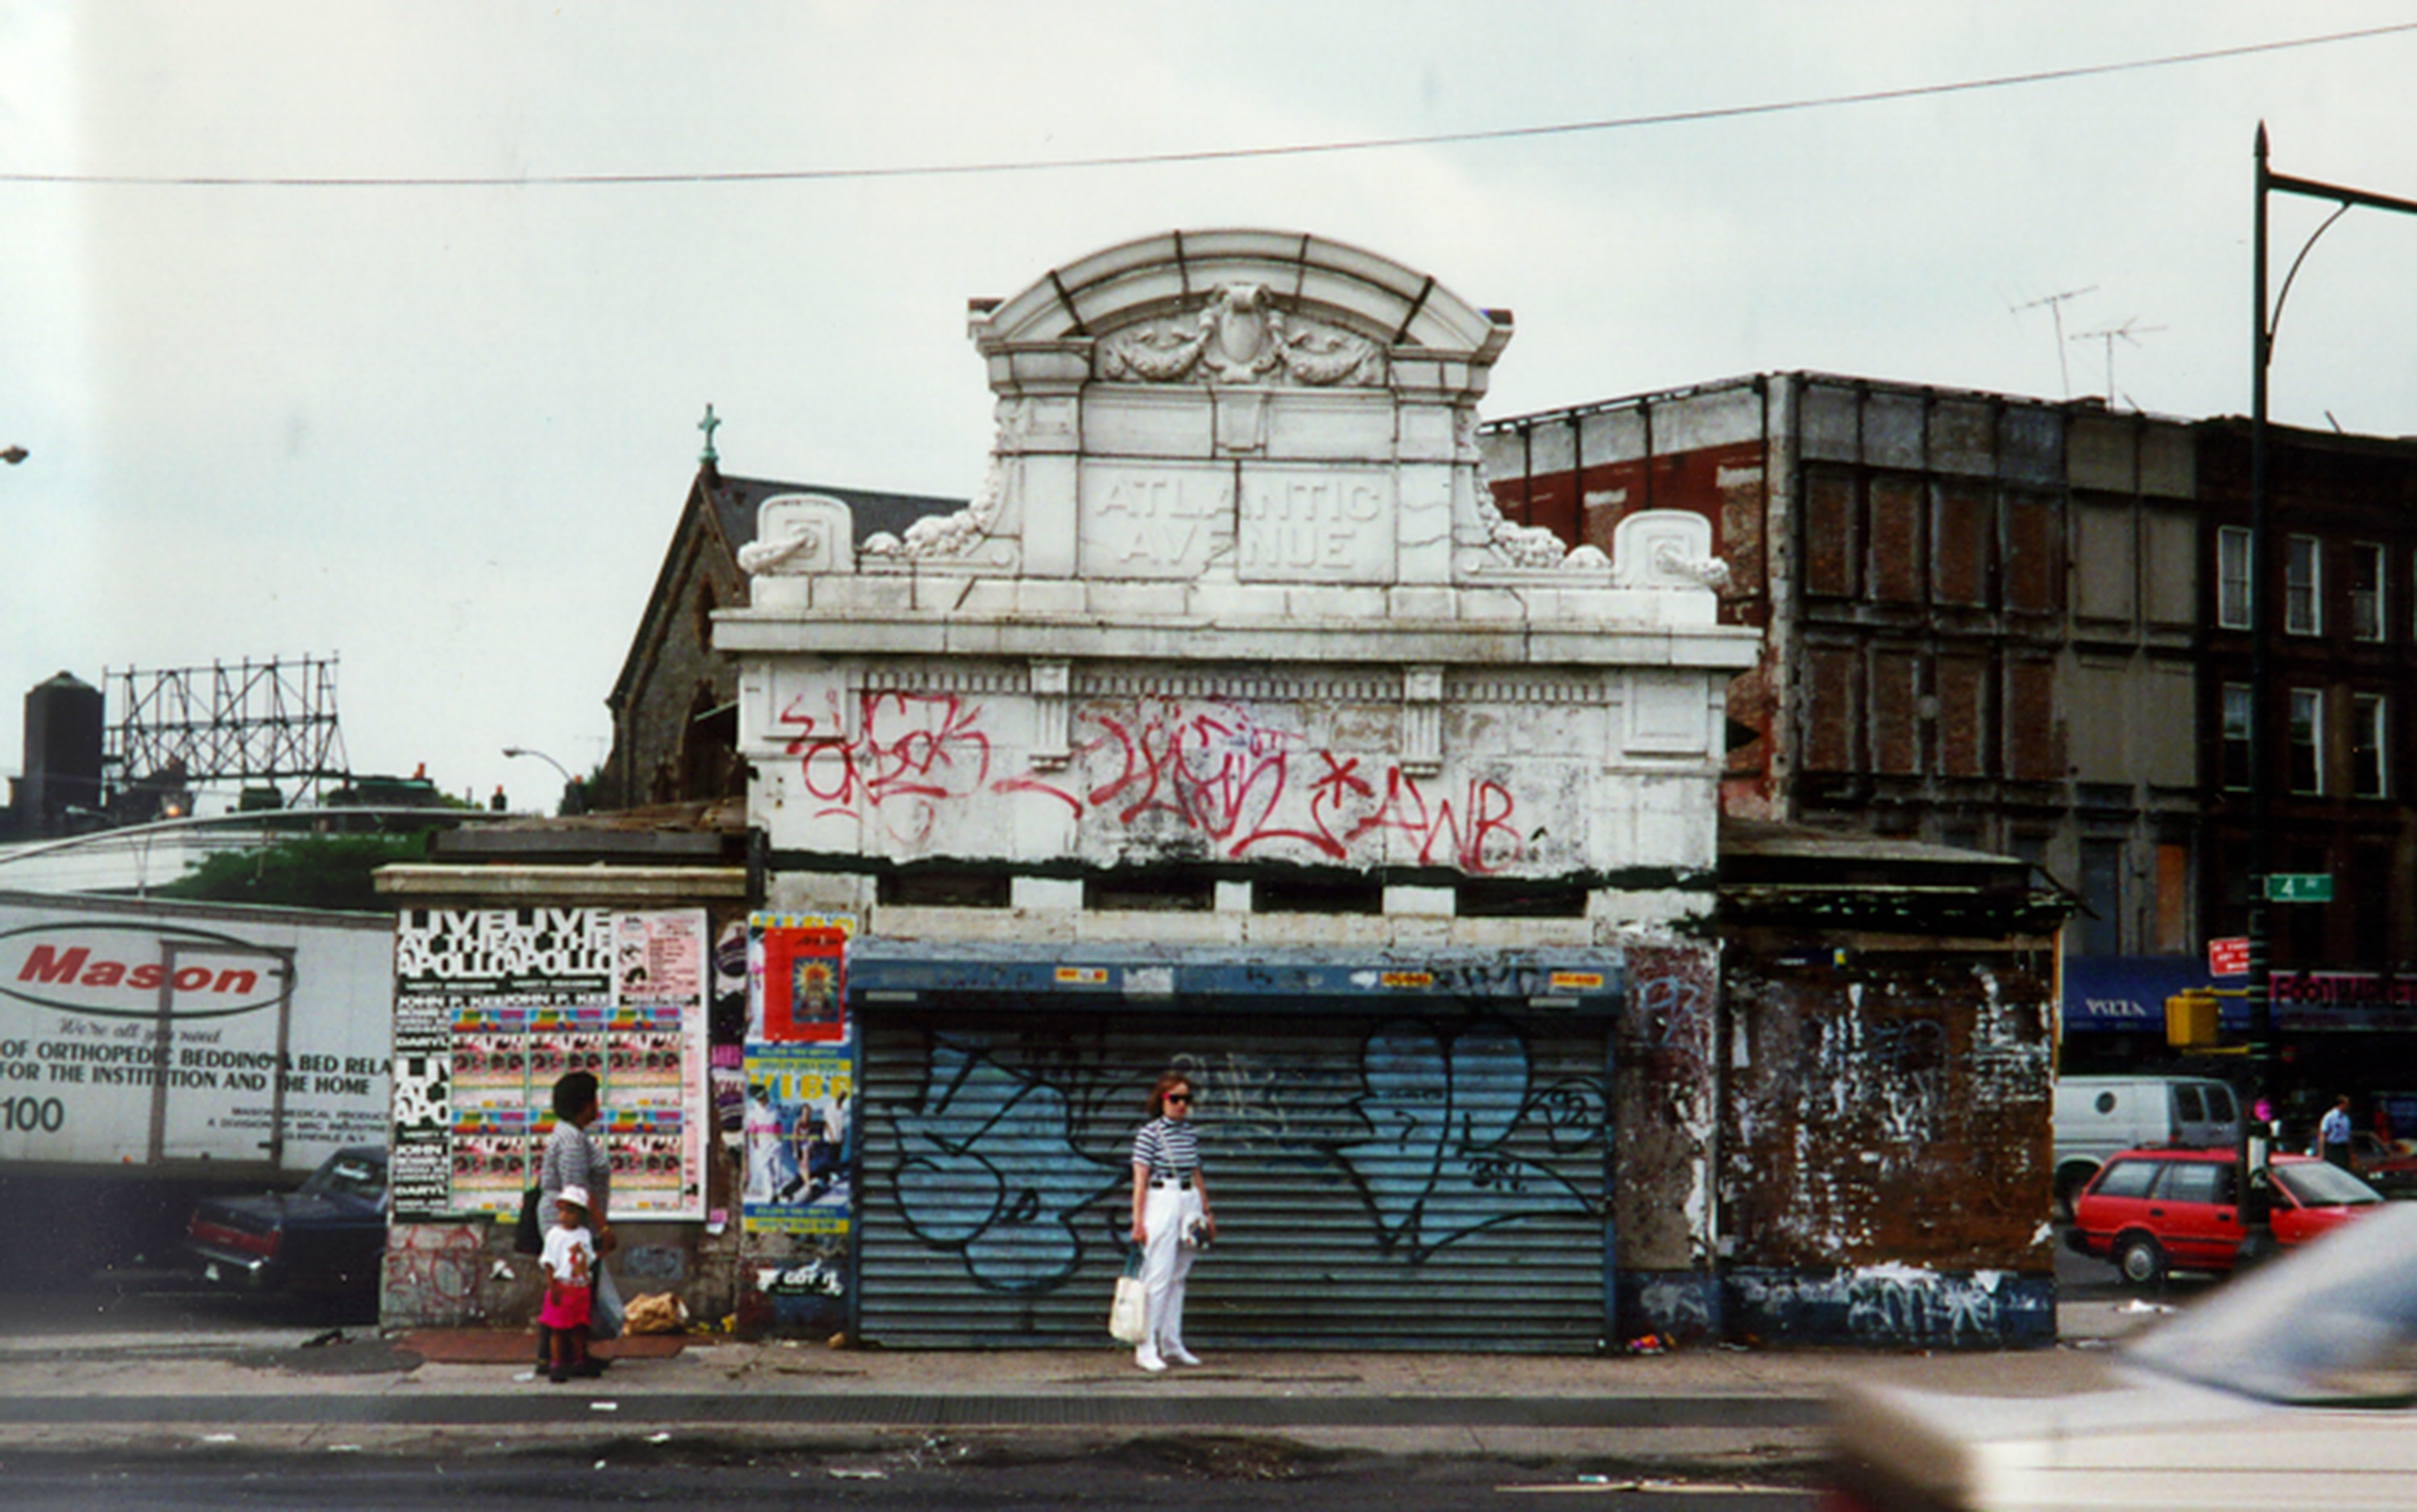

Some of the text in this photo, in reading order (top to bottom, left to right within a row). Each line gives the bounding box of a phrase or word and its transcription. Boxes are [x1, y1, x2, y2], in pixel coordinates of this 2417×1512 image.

[1097, 479, 1381, 521] ATLANTIC
[1119, 524, 1357, 570] AVENUE
[2281, 877, 2295, 898] 4
[400, 910, 504, 935] LIVE
[505, 908, 611, 934] LIVE
[17, 944, 257, 994] Mason
[398, 948, 505, 980] APOLLO
[505, 946, 611, 976] APOLLO
[2084, 998, 2148, 1017] PIZZA
[179, 1028, 222, 1044] need
[1, 1040, 27, 1058] OF
[37, 1042, 172, 1066] ORTHOPEDIC
[180, 1048, 272, 1071] BEDDING
[299, 1054, 338, 1072] BED
[50, 1063, 85, 1083] THE
[93, 1066, 217, 1088] INSTITUTION
[223, 1073, 267, 1091] AND
[276, 1075, 308, 1092] THE
[315, 1075, 371, 1095] HOME
